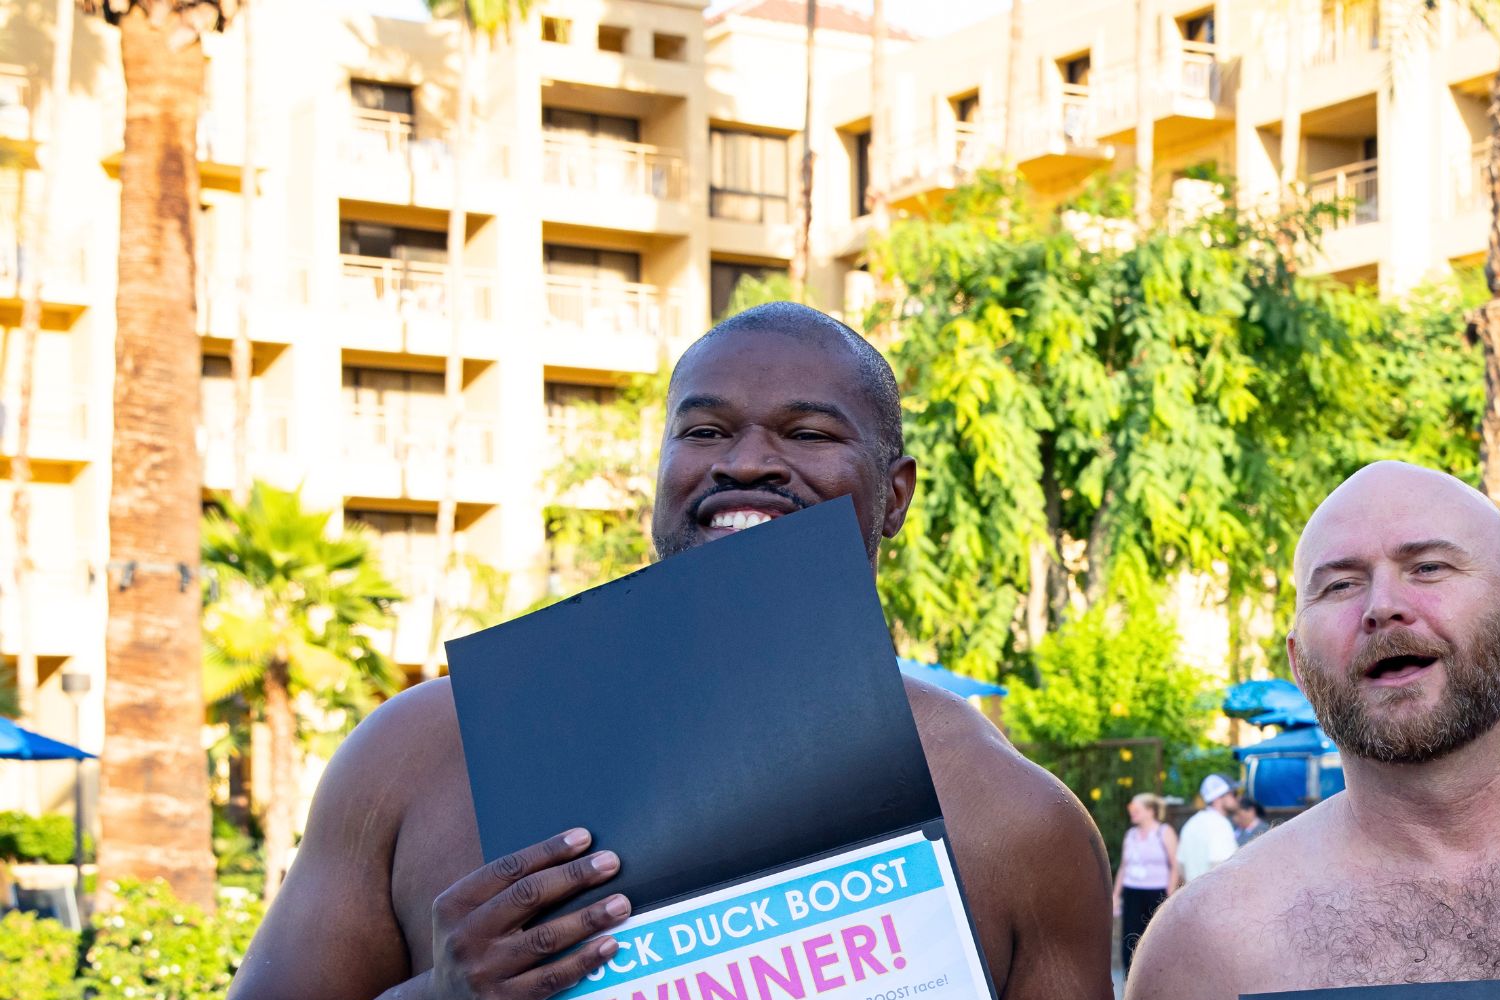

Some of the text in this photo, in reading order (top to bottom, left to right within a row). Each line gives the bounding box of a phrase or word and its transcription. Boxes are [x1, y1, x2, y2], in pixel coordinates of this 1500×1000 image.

[586, 857, 908, 981] CK DUCK BOOST
[913, 974, 949, 994] race!
